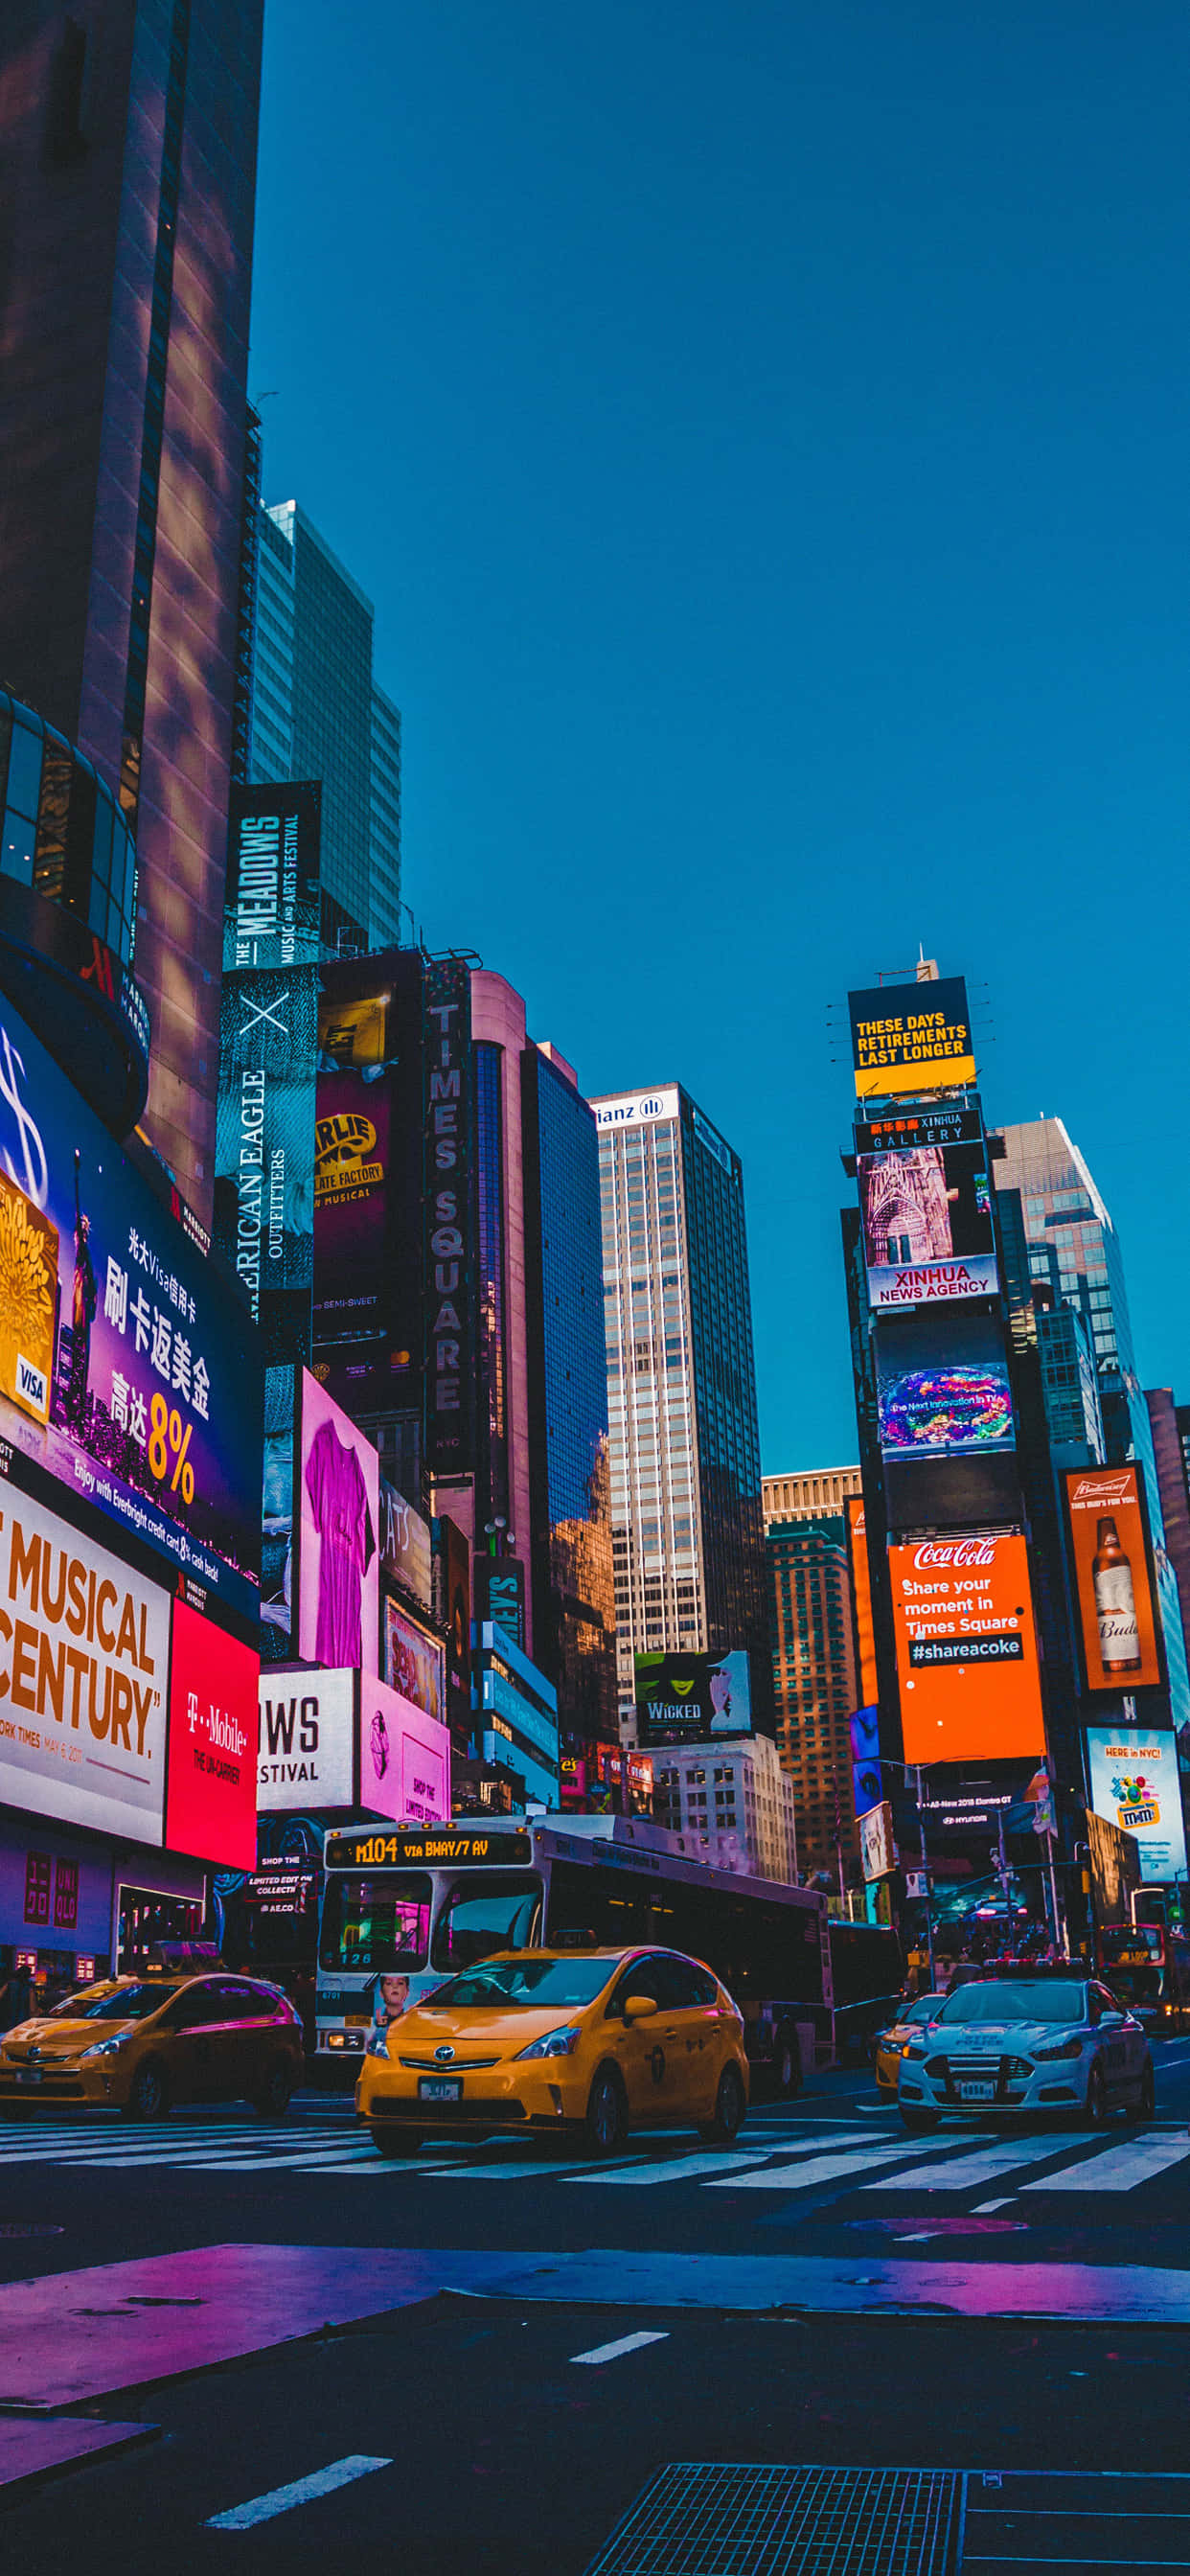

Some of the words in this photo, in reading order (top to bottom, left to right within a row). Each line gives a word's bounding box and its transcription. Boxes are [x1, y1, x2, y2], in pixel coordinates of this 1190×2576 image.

[284, 814, 299, 869] FESTIVAL
[237, 816, 280, 936] MEADOWS
[283, 871, 297, 903] ARTS
[285, 906, 293, 922] AND
[236, 942, 250, 966] THE
[281, 925, 296, 964] MUSIC
[857, 1018, 904, 1037] THESE
[907, 1012, 946, 1030] DAYS
[858, 1024, 967, 1051] RETIREMENTS
[859, 1049, 898, 1067] LAST
[904, 1041, 964, 1061] LONGER
[430, 1002, 462, 1169] TIMES
[240, 1070, 265, 1166] EAGLE
[921, 1114, 962, 1129] XINHUA
[874, 1127, 962, 1148] GALLERY
[339, 1164, 381, 1186] FACTORY
[268, 1148, 286, 1259] OUTFITTERS
[324, 1188, 371, 1207] MUSICAL
[895, 1266, 971, 1288] XINHUA
[431, 1190, 464, 1411] SQUARE
[880, 1287, 923, 1302] NEWS
[927, 1280, 989, 1298] AGENCY
[103, 1254, 211, 1422] 刷卡返美金
[19, 1364, 44, 1404] VISA
[74, 1458, 97, 1494] Enjoy
[96, 1479, 114, 1503] with
[113, 1488, 149, 1530] Everbright
[149, 1517, 167, 1543] credit
[191, 1551, 205, 1572] cash
[8, 1519, 155, 1676] MUSICAL
[904, 1579, 950, 1596] Share
[954, 1578, 992, 1595] your
[904, 1598, 973, 1616] moment
[977, 1597, 994, 1610] in
[905, 1620, 955, 1636] Times
[959, 1617, 1018, 1633] Square
[912, 1639, 1020, 1661] #shareacoke
[17, 1726, 41, 1749] TIMES
[1106, 1747, 1129, 1758] HERE
[1139, 1748, 1161, 1759] NYC!
[262, 1856, 283, 1866] SHOP
[284, 1855, 300, 1865] THE
[355, 1837, 398, 1863] M104
[404, 1845, 423, 1857] VIA
[424, 1840, 469, 1857] BWAY/7
[471, 1840, 489, 1856] AV
[249, 1875, 280, 1886] LIMITED
